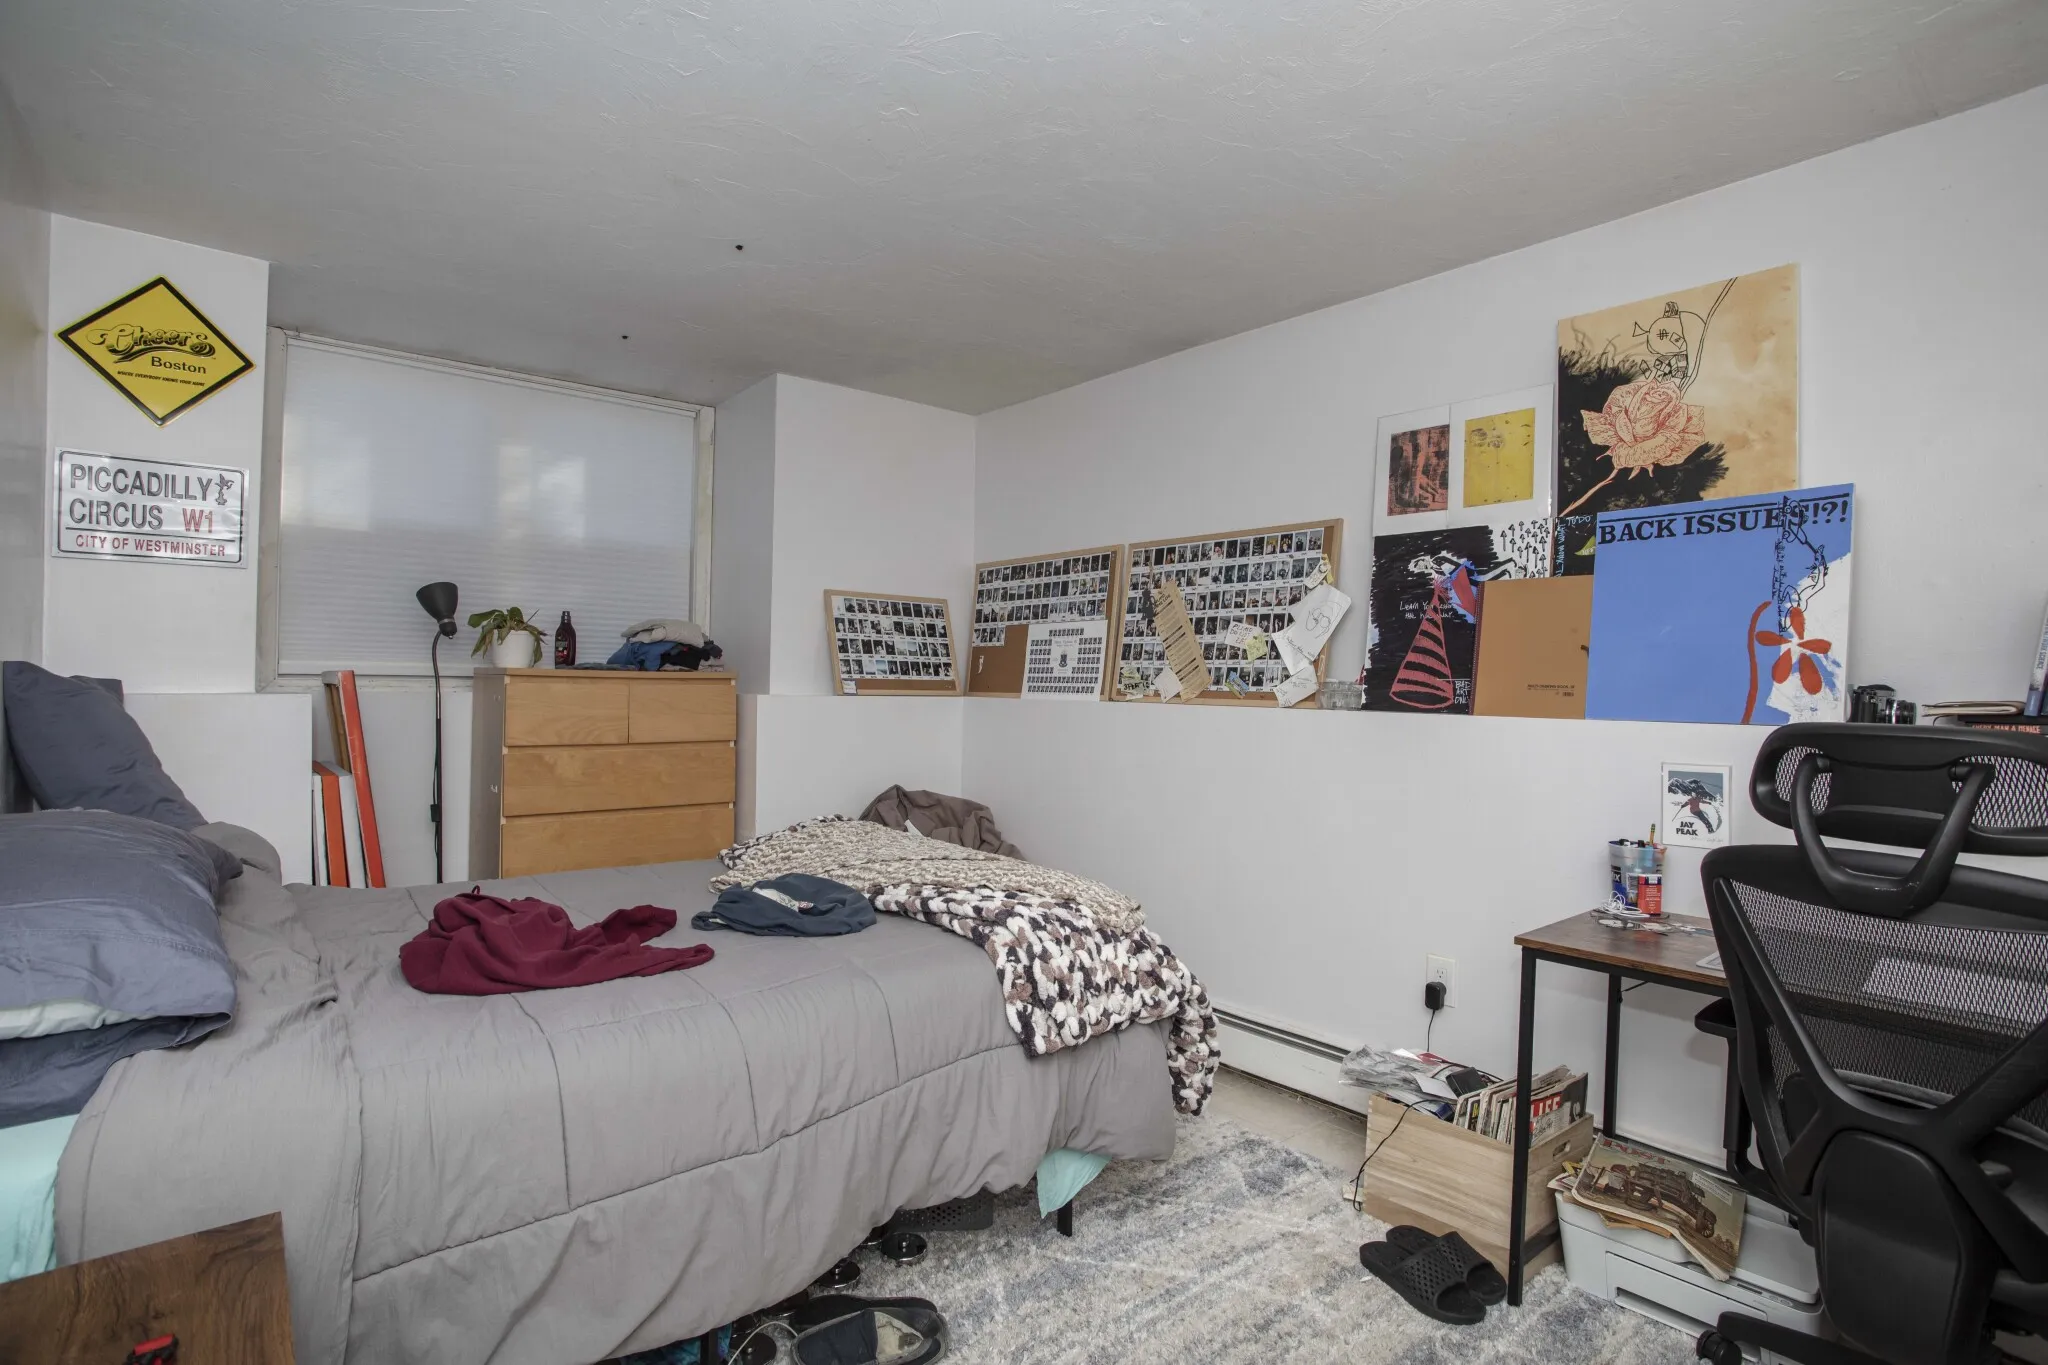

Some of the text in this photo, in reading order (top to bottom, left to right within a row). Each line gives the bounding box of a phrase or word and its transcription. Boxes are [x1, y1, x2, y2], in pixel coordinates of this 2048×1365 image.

[87, 323, 216, 359] Cheers
[151, 356, 207, 374] Boston
[70, 463, 213, 502] PICCADILLY
[69, 497, 214, 533] CIRCUS W1
[1598, 516, 1677, 544] BACK
[75, 534, 225, 557] CITY OF WESTMINSTER
[1675, 827, 1698, 836] PEAK
[1679, 821, 1695, 829] JAY
